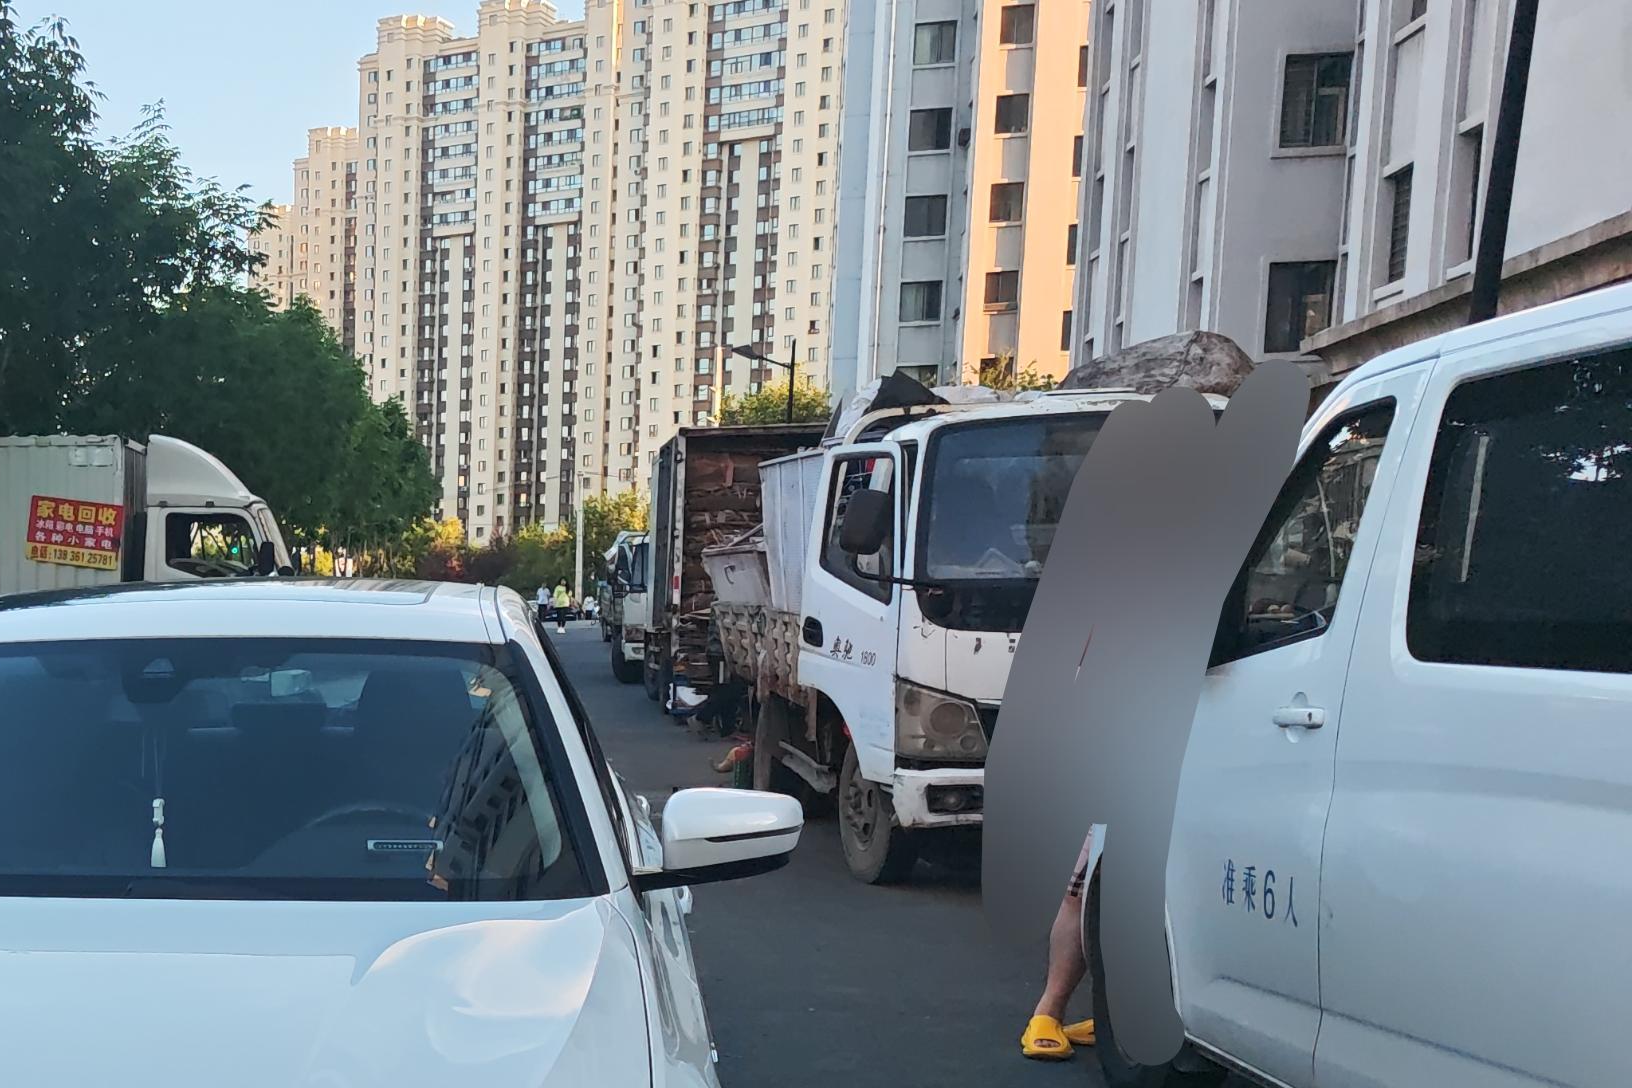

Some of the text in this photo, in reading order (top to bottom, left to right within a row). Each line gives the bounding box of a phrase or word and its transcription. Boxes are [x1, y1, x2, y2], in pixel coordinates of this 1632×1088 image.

[36, 500, 117, 525] 家电回收
[34, 530, 113, 550] 各种小家电
[95, 525, 114, 538] 手机
[1222, 858, 1299, 928] 准乘6人
